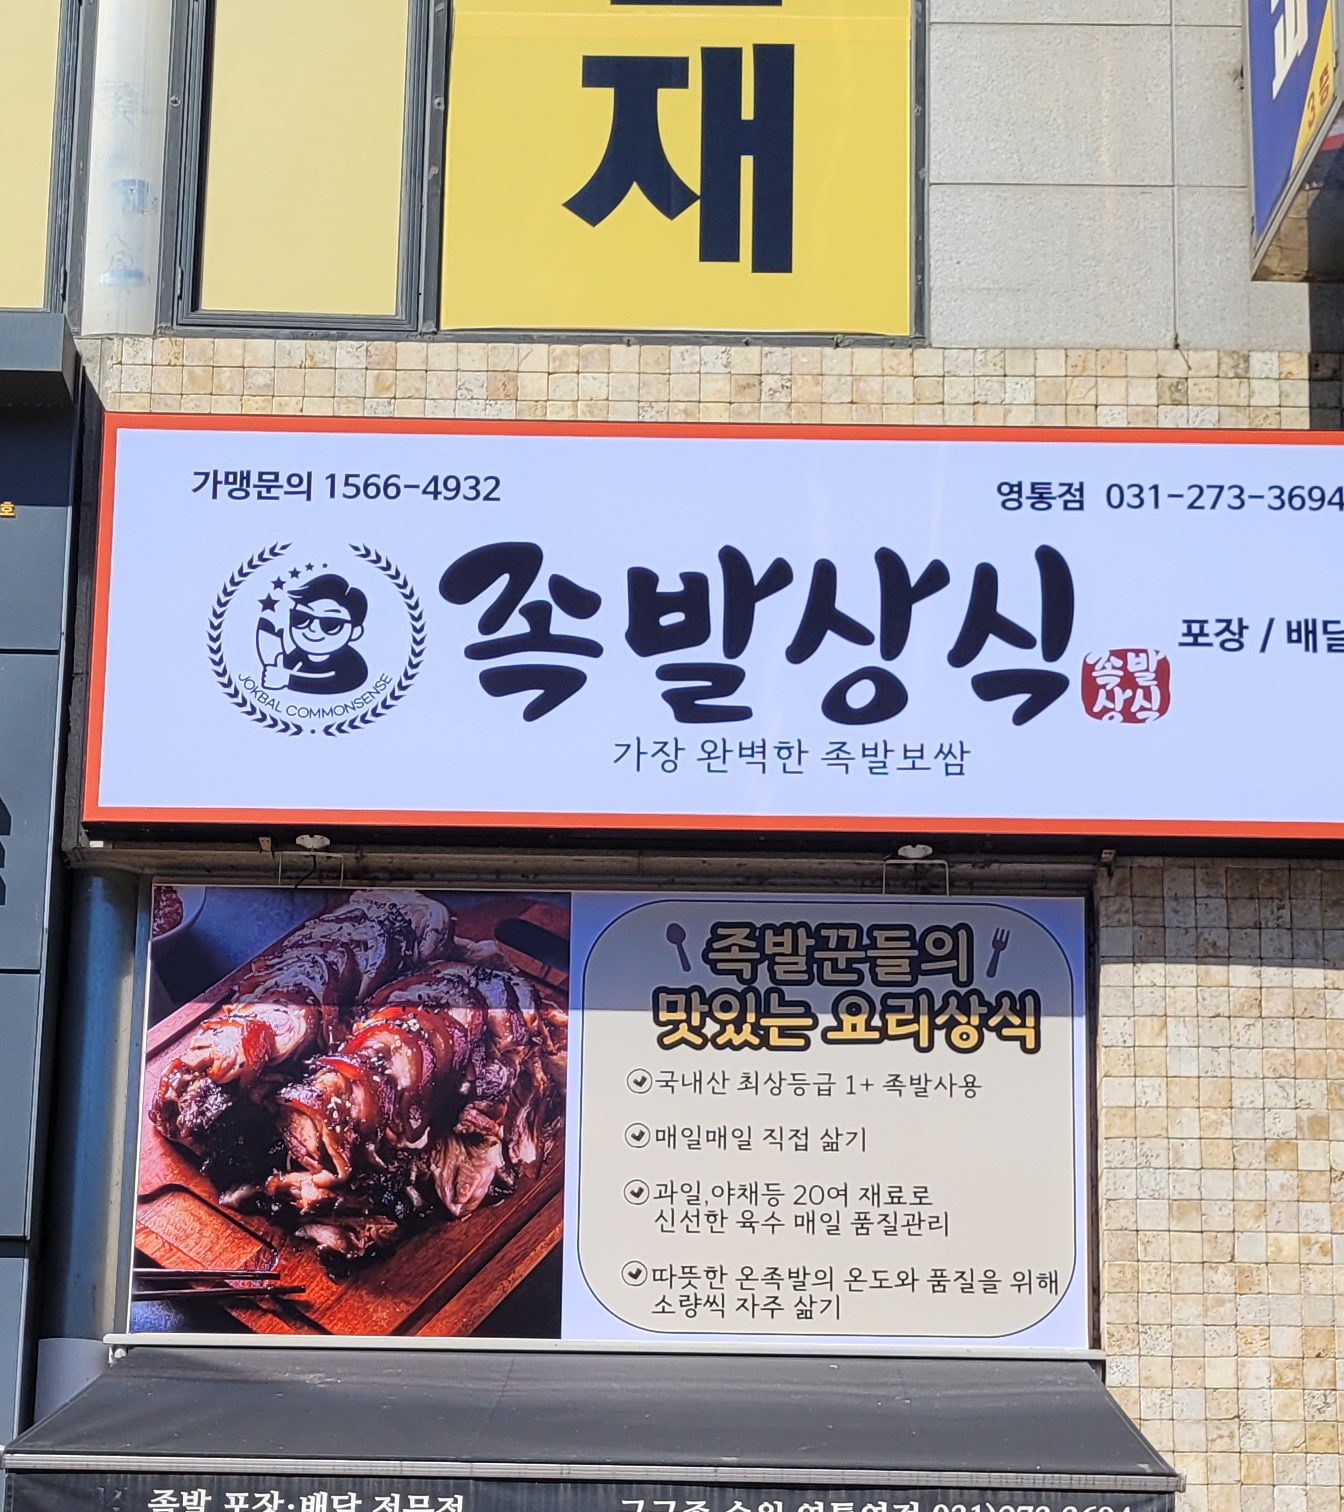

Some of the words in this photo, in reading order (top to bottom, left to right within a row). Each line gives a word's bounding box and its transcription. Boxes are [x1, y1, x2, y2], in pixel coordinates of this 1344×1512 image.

[561, 43, 795, 274] 재
[191, 469, 313, 501] 가맹문의
[325, 473, 501, 503] 1566-4932
[996, 480, 1086, 511] 영통점
[438, 541, 1074, 725] 족발상식
[1177, 617, 1247, 652] 포장
[238, 673, 282, 713] JOKBAL
[286, 673, 393, 719] COMMONSENSE
[612, 736, 685, 774] 가장
[696, 737, 809, 776] 완벽한
[820, 739, 971, 777] 족발보쌈
[701, 921, 974, 986] 족발꾼들의
[652, 985, 819, 1052] 맛있는
[820, 987, 1042, 1055] 요리상식
[654, 1069, 730, 1096] 국내산
[736, 1069, 837, 1098] 최상등급
[844, 1074, 875, 1097] 1+
[882, 1072, 983, 1100] 족발사용
[654, 1124, 753, 1152] 매일매일
[762, 1126, 810, 1153] 직접
[819, 1126, 867, 1153] 삶기
[653, 1180, 786, 1207] 과일,야채등
[793, 1182, 849, 1208] 20여
[858, 1183, 933, 1208] 재료로
[654, 1208, 729, 1235] 신선한
[735, 1210, 785, 1236] 육수
[793, 1210, 842, 1237] 매일
[850, 1211, 950, 1237] 품질관리
[652, 1264, 728, 1291] 따뜻한
[734, 1265, 835, 1292] 온족발의
[843, 1266, 919, 1293] 온도와
[927, 1267, 1002, 1294] 품질을
[1010, 1268, 1059, 1296] 위해
[651, 1292, 727, 1319] 소량씩
[735, 1294, 784, 1319] 자주
[793, 1295, 841, 1321] 삶기
